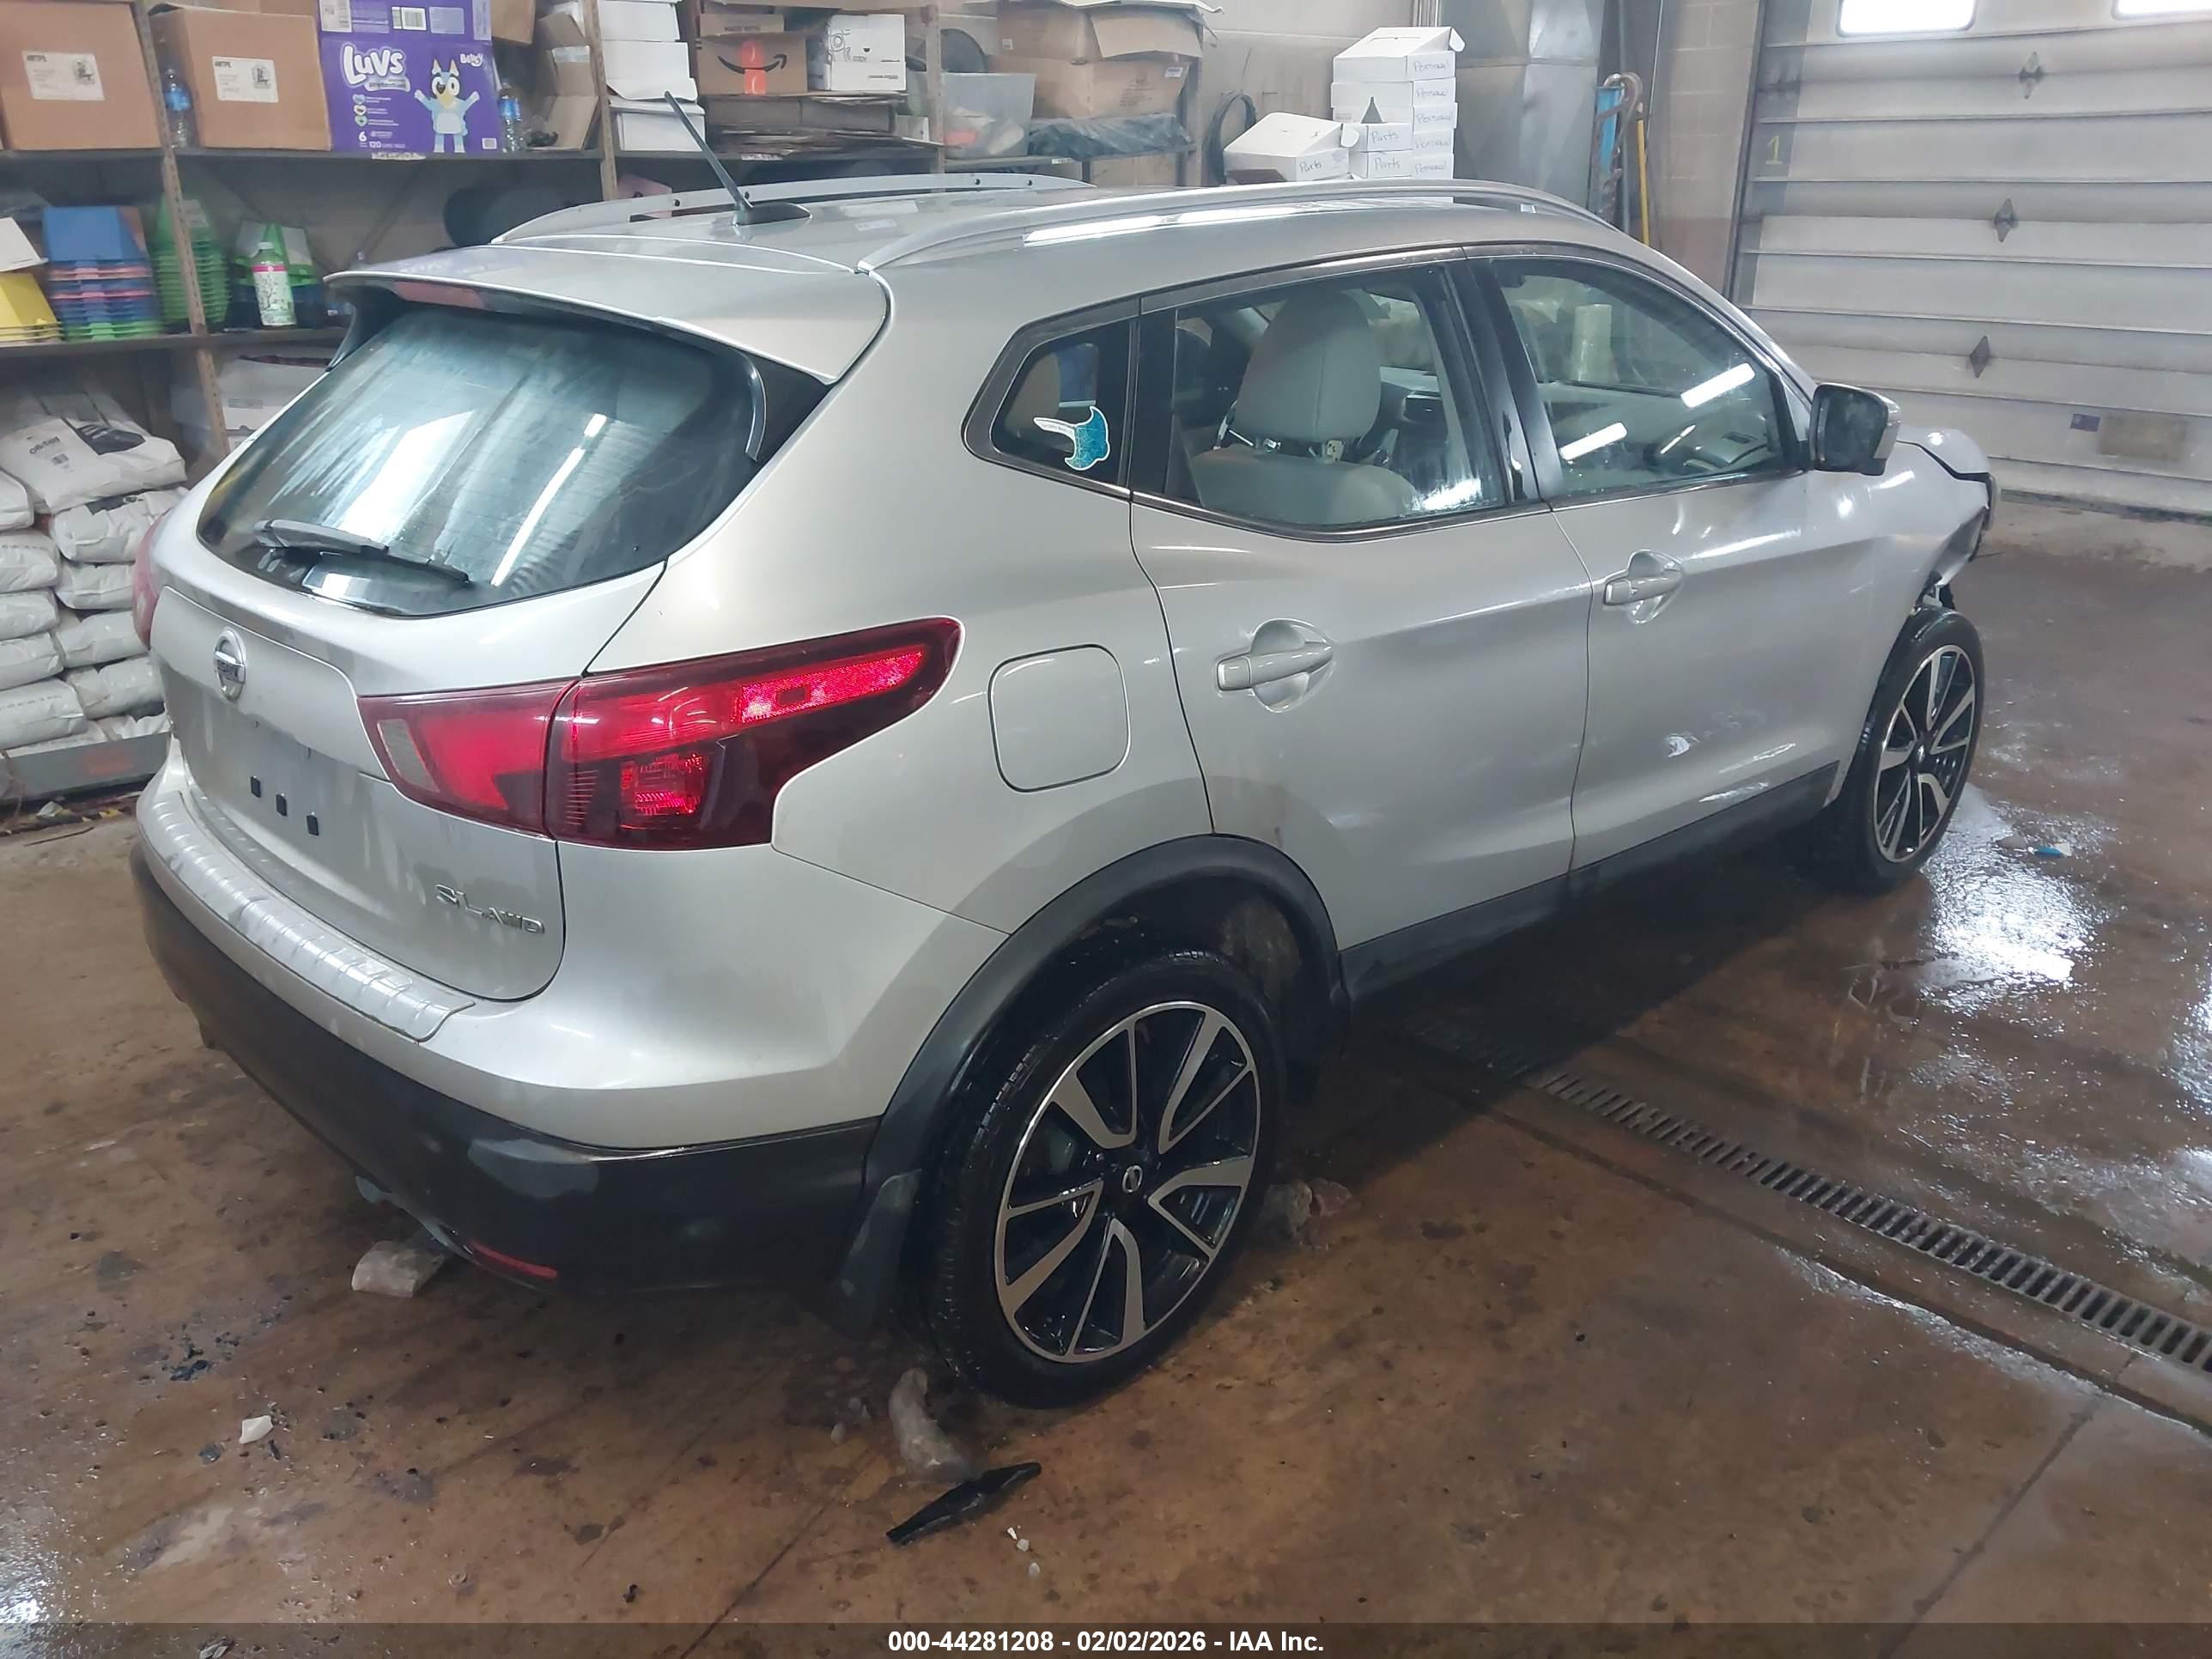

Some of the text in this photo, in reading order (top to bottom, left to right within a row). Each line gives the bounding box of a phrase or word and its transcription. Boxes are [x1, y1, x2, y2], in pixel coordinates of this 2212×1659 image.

[358, 131, 368, 142] 6
[1371, 129, 1399, 143] Parts
[1415, 137, 1451, 149] Peronal
[1766, 135, 1784, 165] 1
[1298, 159, 1322, 173] Parts
[1374, 156, 1401, 171] Parts
[435, 884, 545, 934] SL AWD
